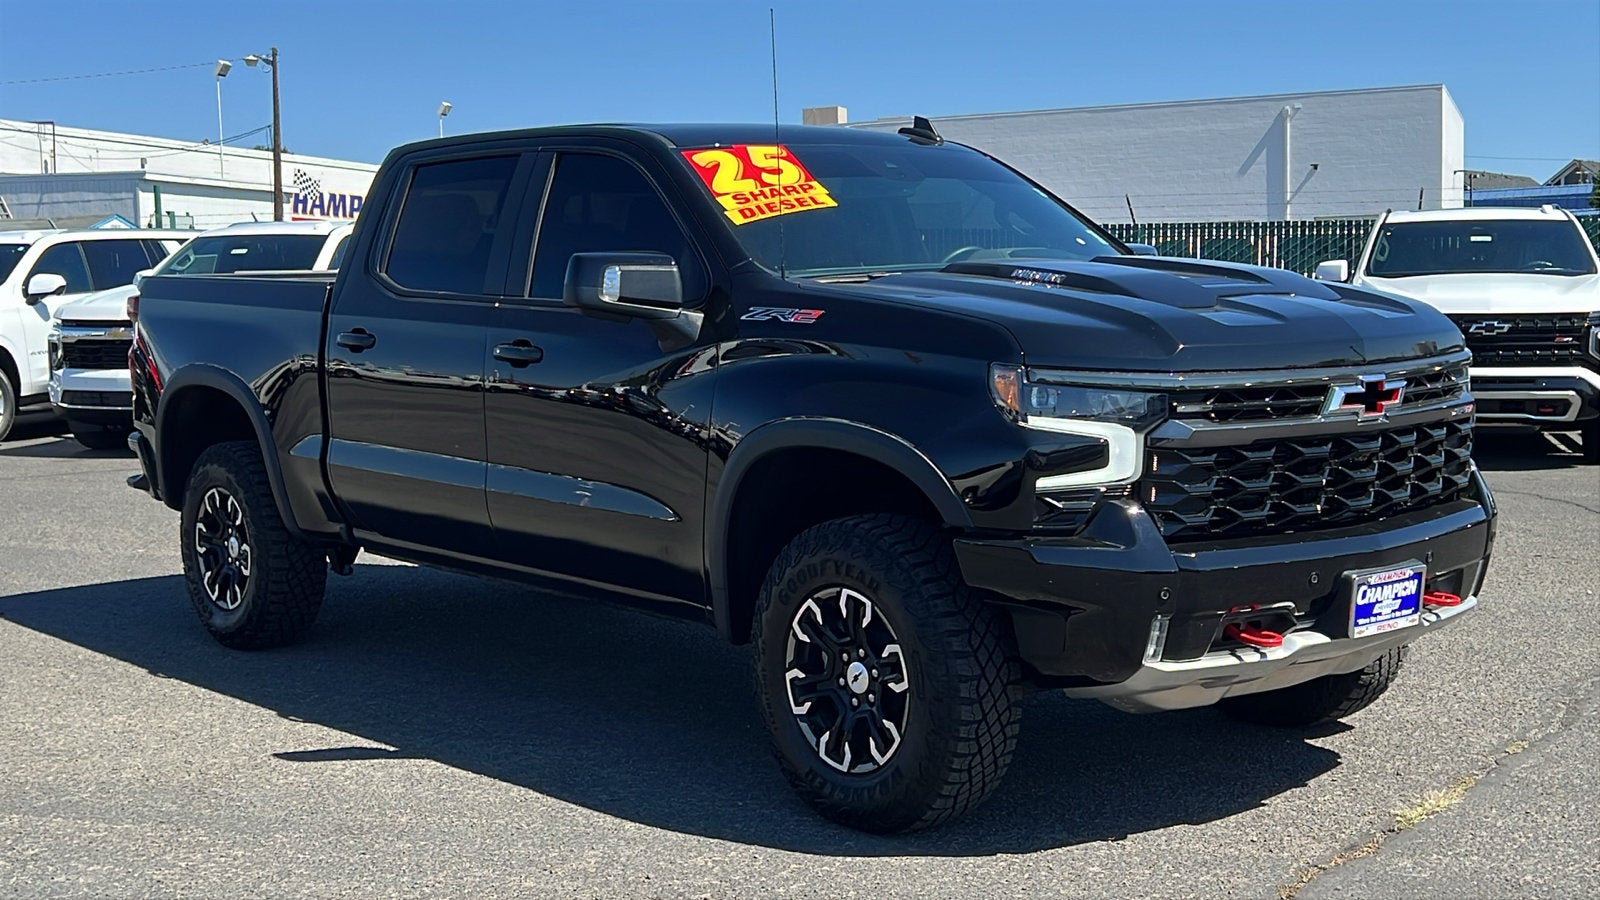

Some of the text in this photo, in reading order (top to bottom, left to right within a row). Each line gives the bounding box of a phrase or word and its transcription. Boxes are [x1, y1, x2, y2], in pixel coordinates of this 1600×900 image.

[692, 146, 806, 194] 25
[732, 183, 816, 205] SHARP
[737, 197, 826, 220] DIESEL
[740, 306, 825, 323] ZR2
[1357, 579, 1418, 605] CHAMPION
[1377, 621, 1399, 632] RENO
